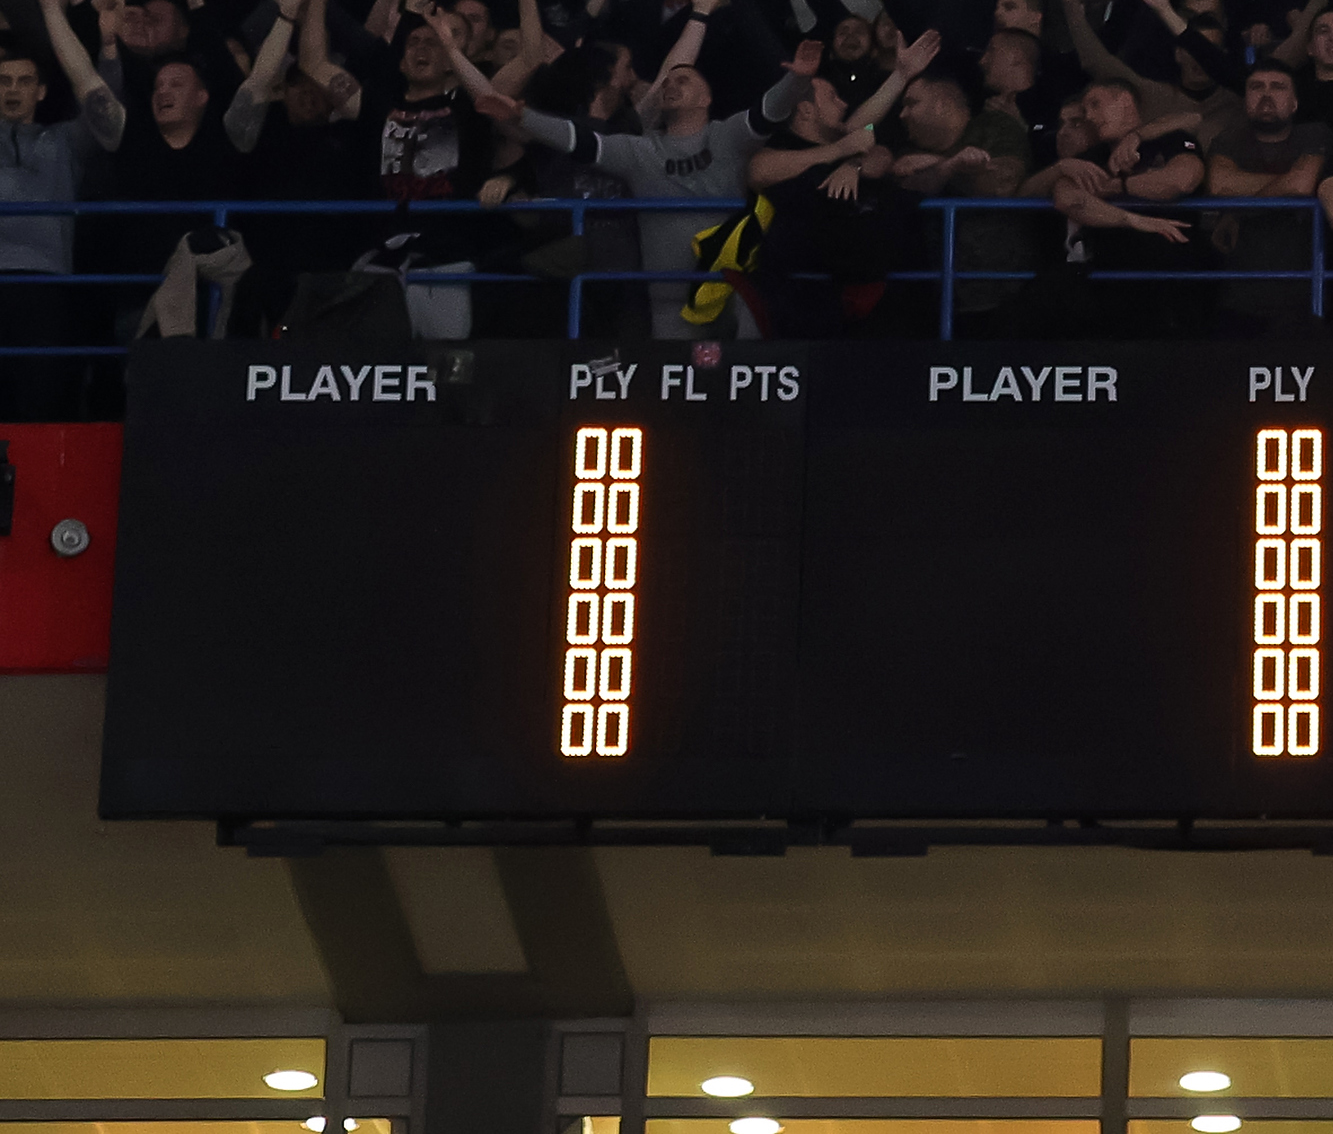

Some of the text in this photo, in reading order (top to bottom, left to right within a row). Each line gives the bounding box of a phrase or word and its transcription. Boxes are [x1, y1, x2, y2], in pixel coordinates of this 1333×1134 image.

[248, 366, 437, 402] PLAYER
[571, 365, 800, 402] PLY FL PTS
[930, 367, 1118, 402] PLAYER
[1250, 367, 1316, 403] PLY
[576, 428, 644, 481] 00
[1257, 429, 1323, 481] 00
[573, 482, 641, 536] 00
[1256, 483, 1323, 536] 00
[570, 537, 638, 591] 00
[1256, 538, 1322, 591] 00
[567, 593, 636, 646] 00
[1255, 593, 1321, 646] 00
[564, 647, 633, 701] 00
[1254, 648, 1321, 701] 00
[561, 703, 630, 756] 00
[1253, 703, 1321, 756] 00
